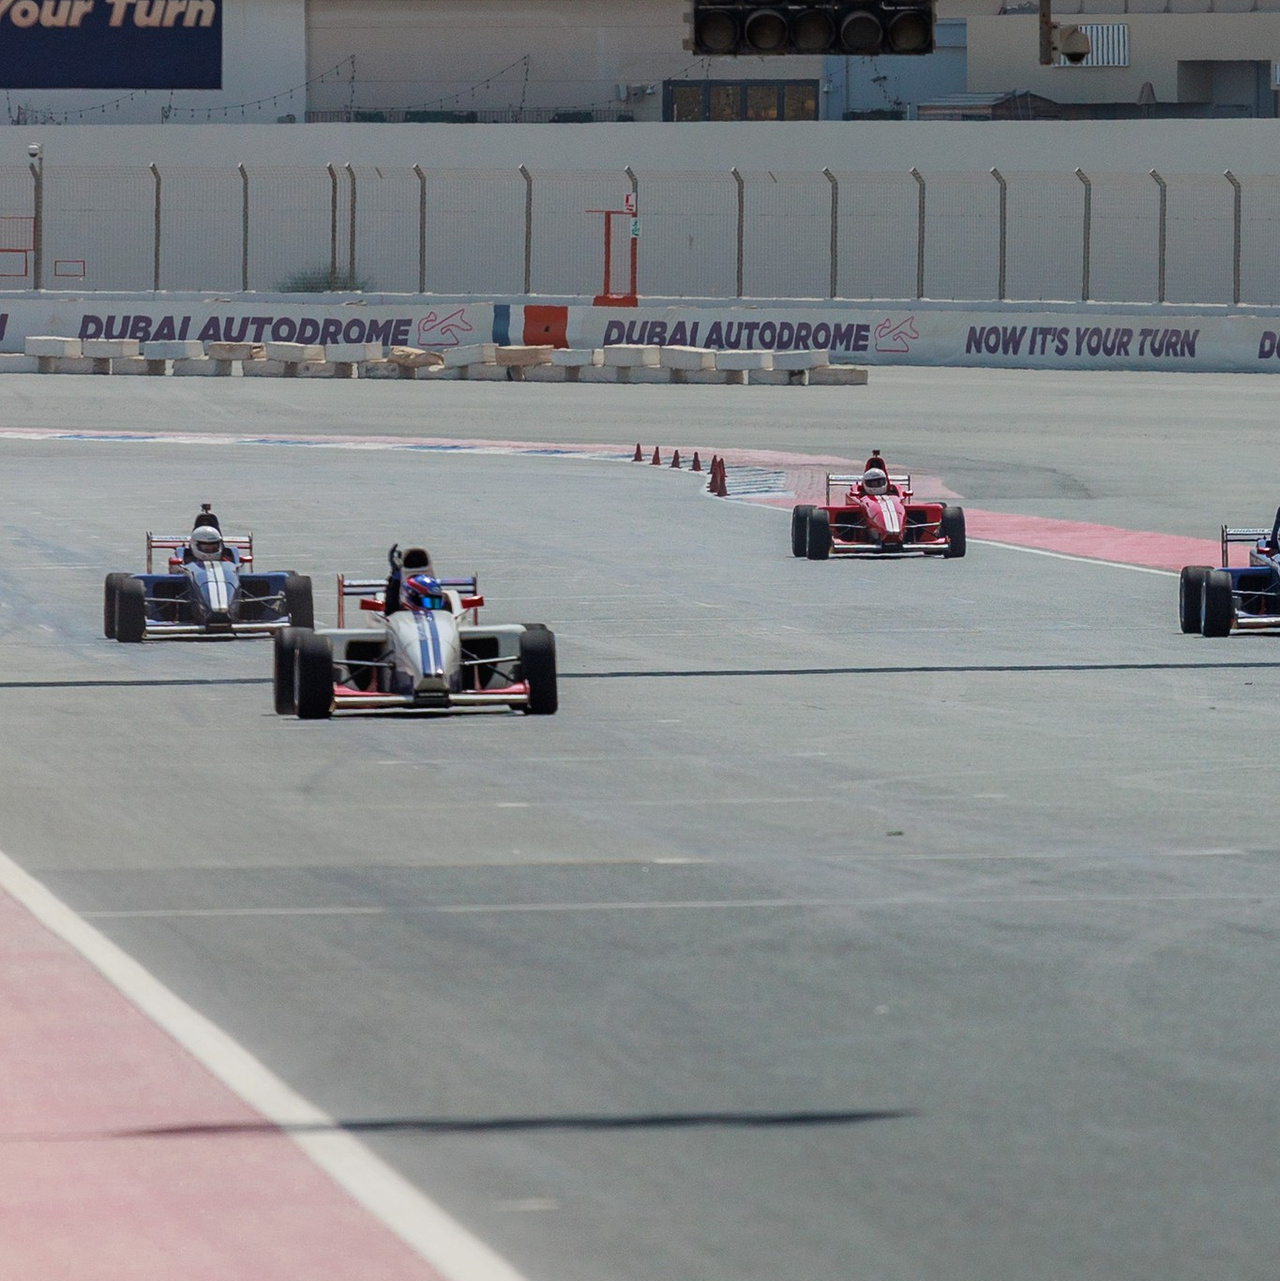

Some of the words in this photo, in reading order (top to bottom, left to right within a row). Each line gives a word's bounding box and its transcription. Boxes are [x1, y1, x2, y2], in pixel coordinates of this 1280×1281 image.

[78, 314, 191, 342] DUBAI
[199, 316, 413, 347] AUTODROME
[603, 320, 699, 348] DUBAI
[704, 320, 870, 352] AUTODROME
[965, 326, 1027, 354] NOW
[1028, 327, 1069, 355] IT'S
[1074, 327, 1131, 357] YOUR
[1138, 328, 1200, 358] TURN
